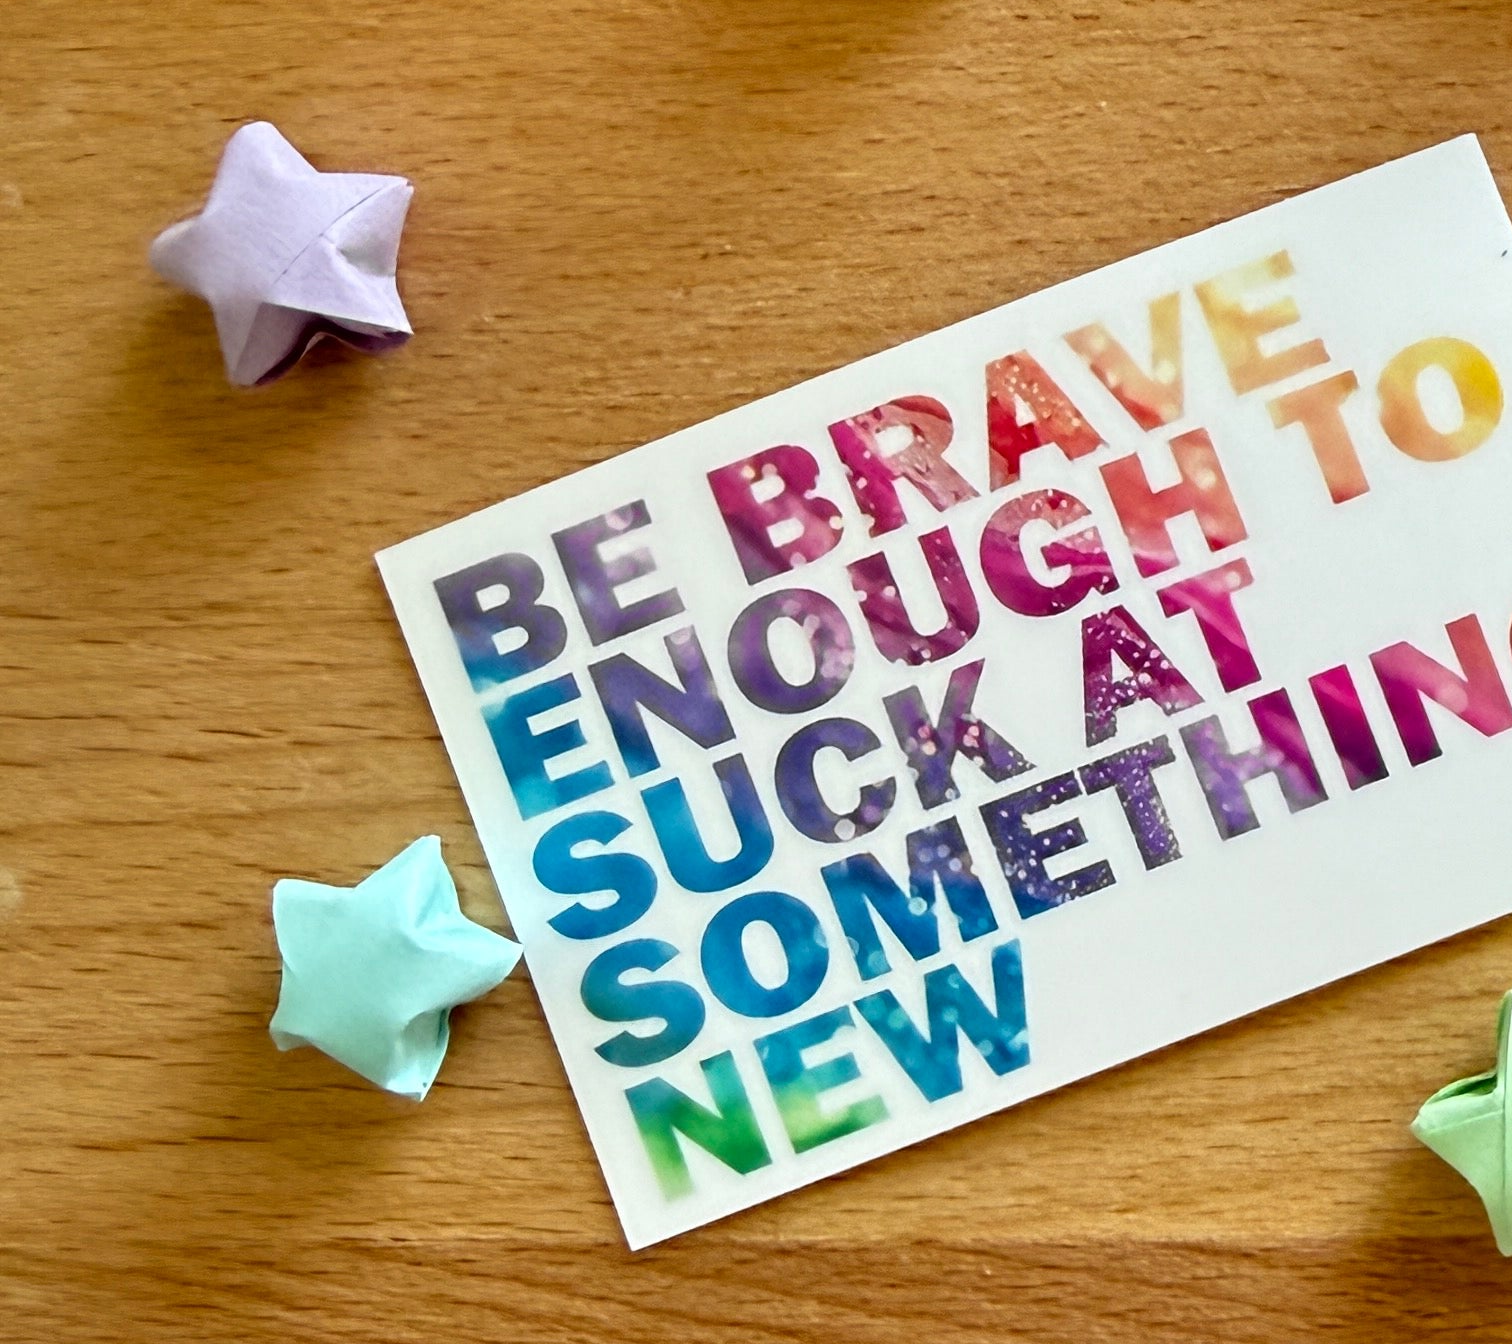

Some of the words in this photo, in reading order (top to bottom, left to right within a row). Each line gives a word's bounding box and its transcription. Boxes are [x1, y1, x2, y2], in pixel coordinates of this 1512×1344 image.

[432, 500, 684, 686] BE
[706, 249, 1330, 585] BRAVE
[480, 427, 1246, 817] ENOUGH
[1268, 337, 1504, 503] TO
[533, 658, 1034, 942] SUCK
[1082, 558, 1270, 748] AT
[624, 939, 1032, 1203] NEW
